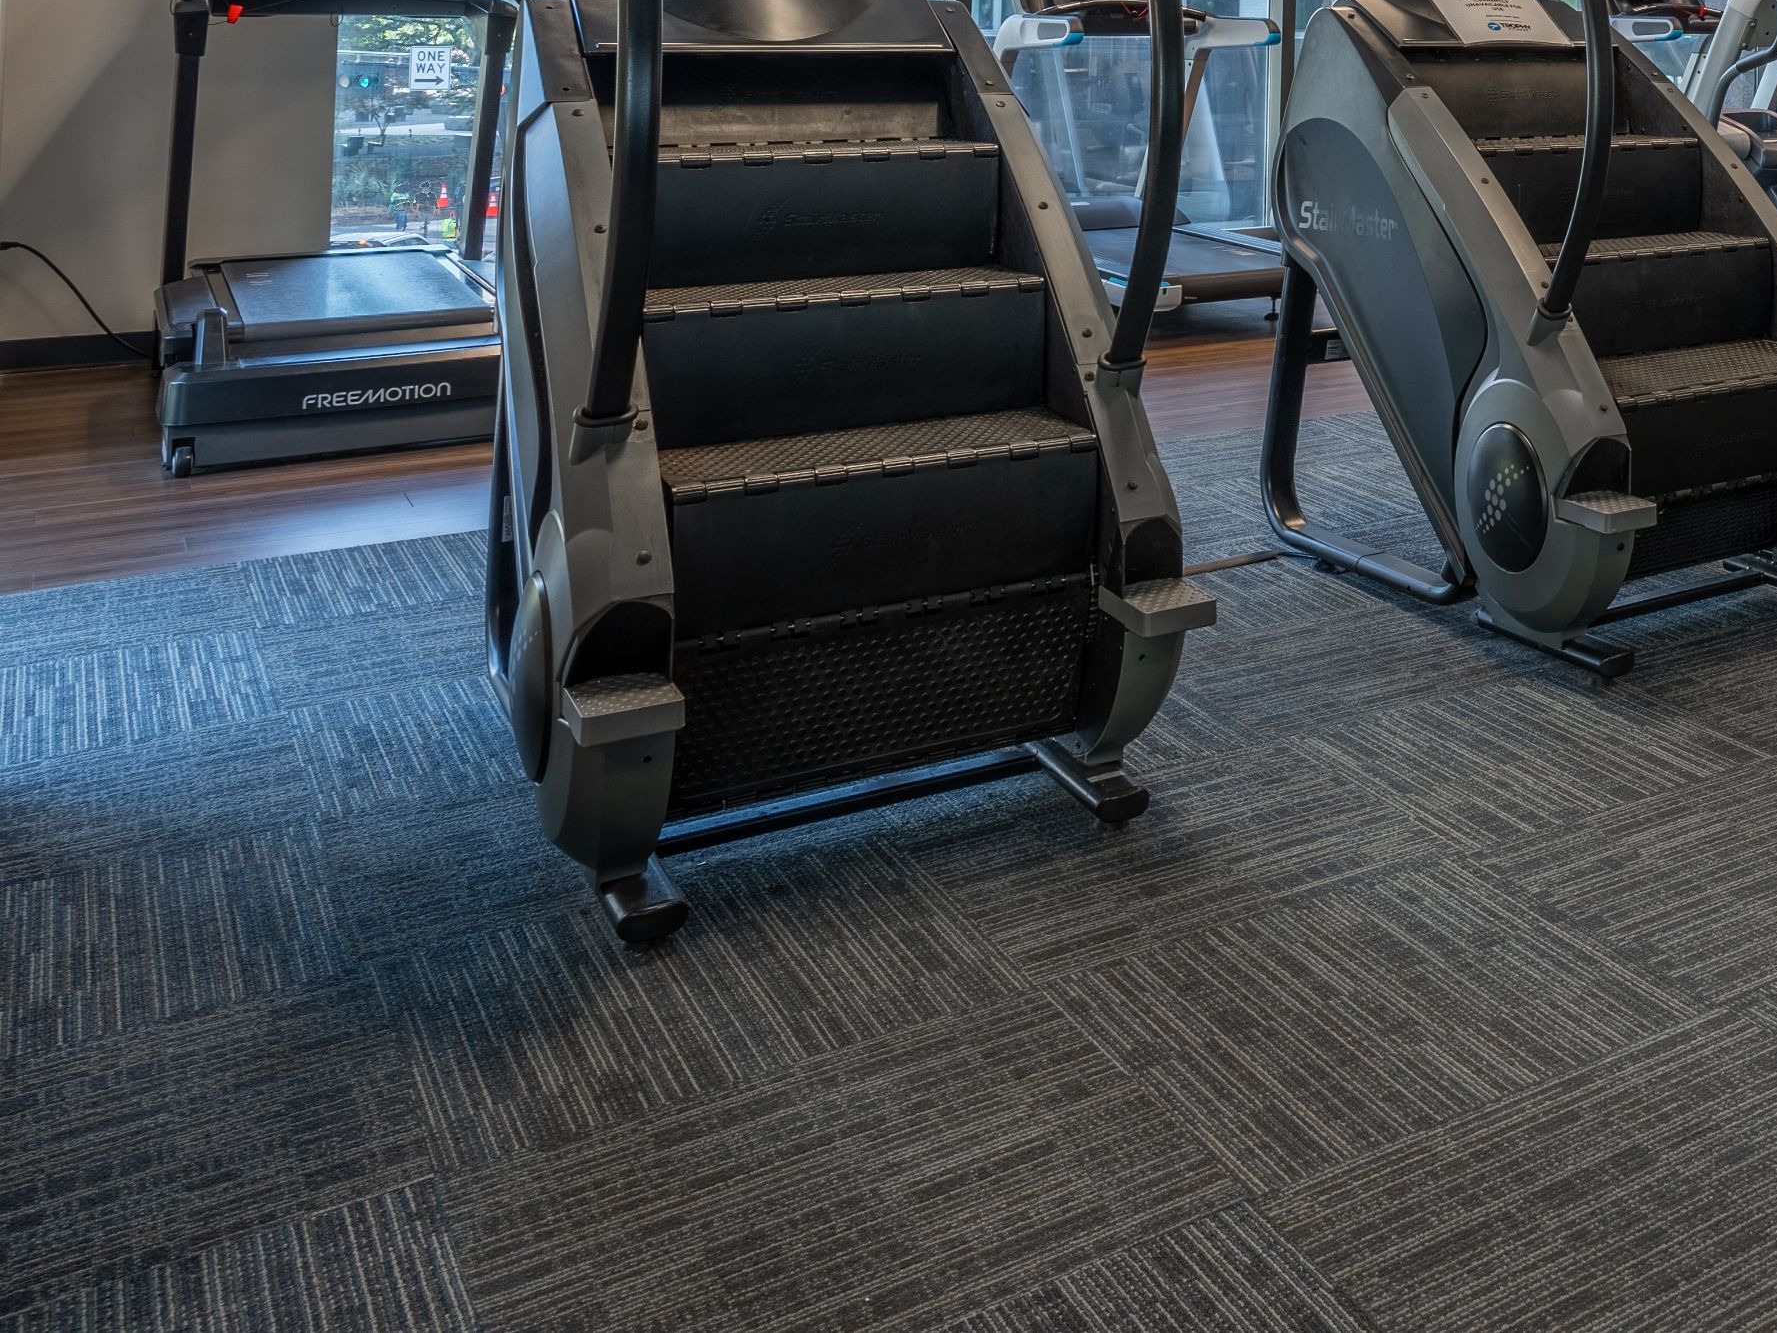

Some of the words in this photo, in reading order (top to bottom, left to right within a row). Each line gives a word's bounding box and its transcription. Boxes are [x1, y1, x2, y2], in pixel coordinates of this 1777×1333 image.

[417, 50, 446, 62] ONE
[416, 62, 446, 74] WAY
[301, 381, 451, 410] FREEMOTION
